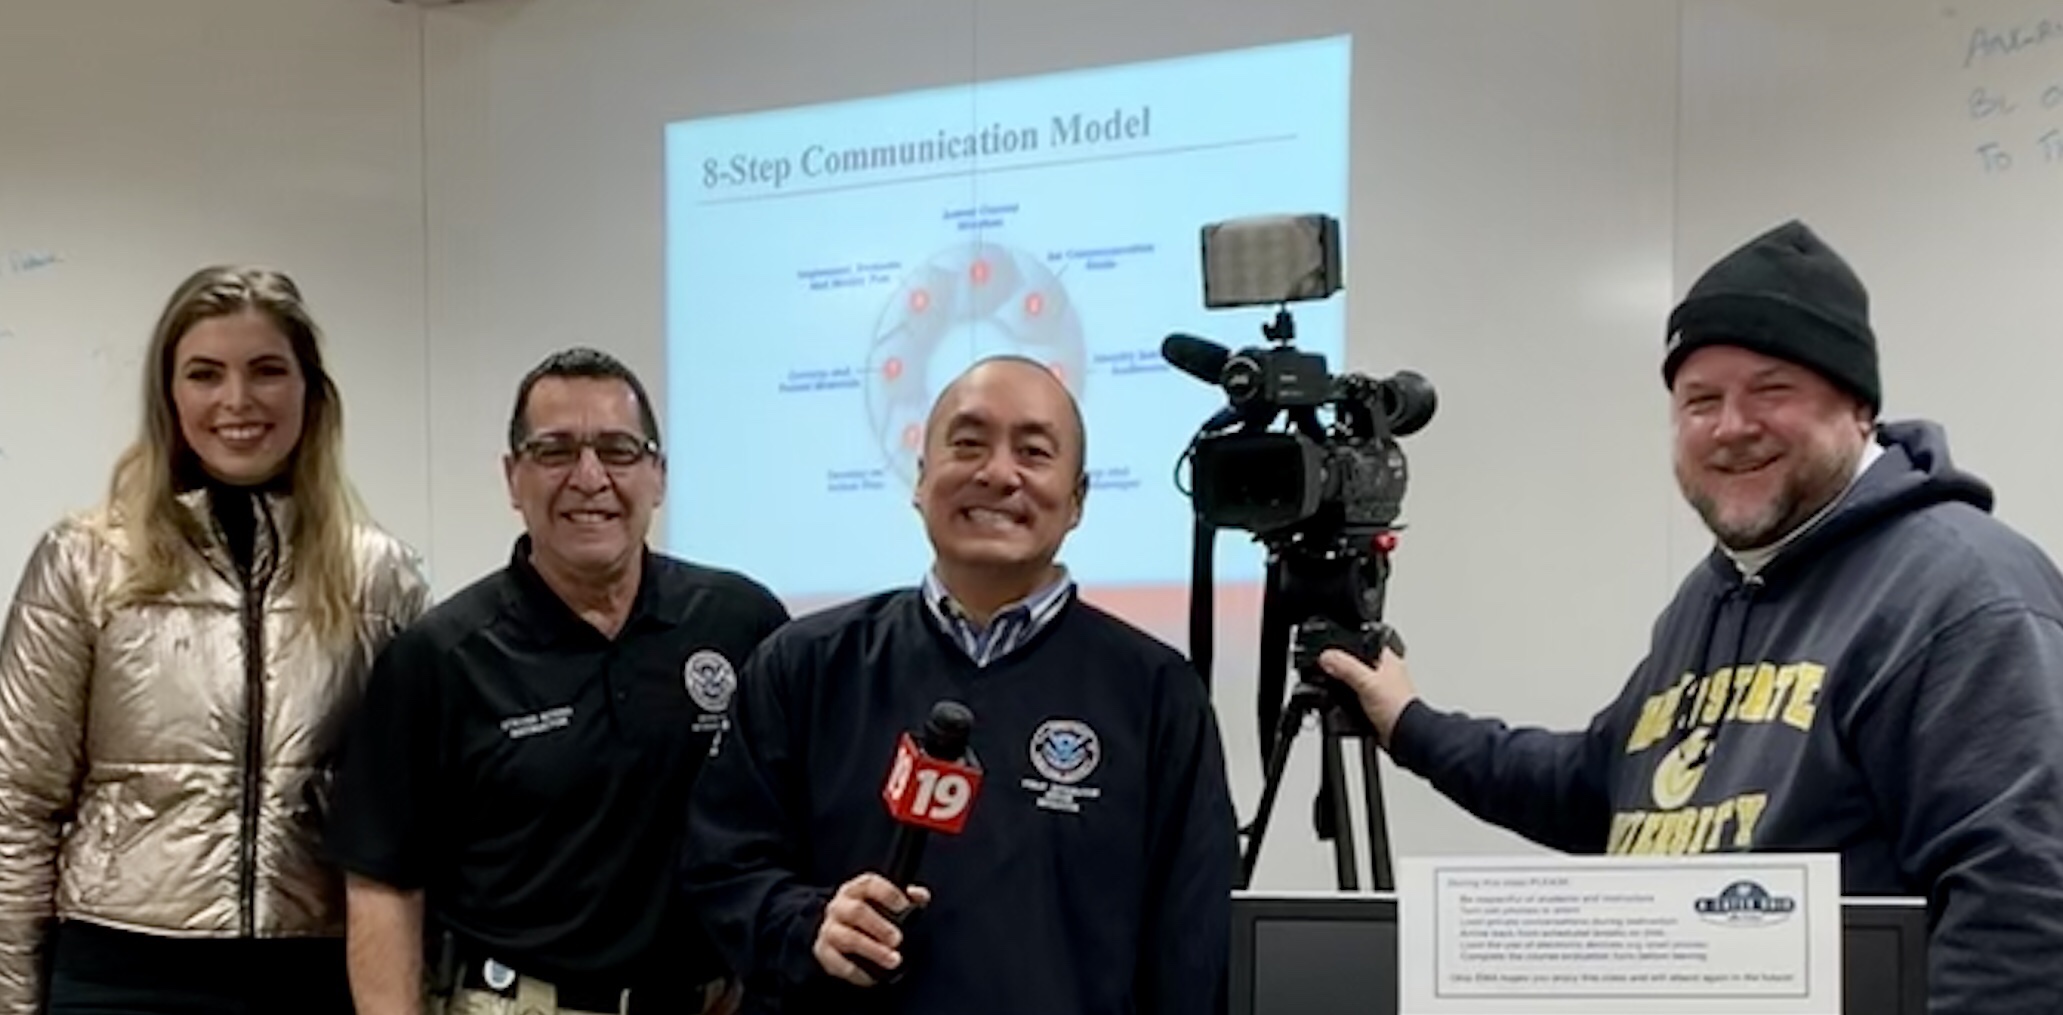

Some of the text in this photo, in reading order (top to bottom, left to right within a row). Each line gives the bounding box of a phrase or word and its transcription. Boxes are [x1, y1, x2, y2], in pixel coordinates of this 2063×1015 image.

[703, 106, 1151, 188] 8-Step Communication Model
[1701, 662, 1827, 732] STATE
[910, 768, 972, 820] 19
